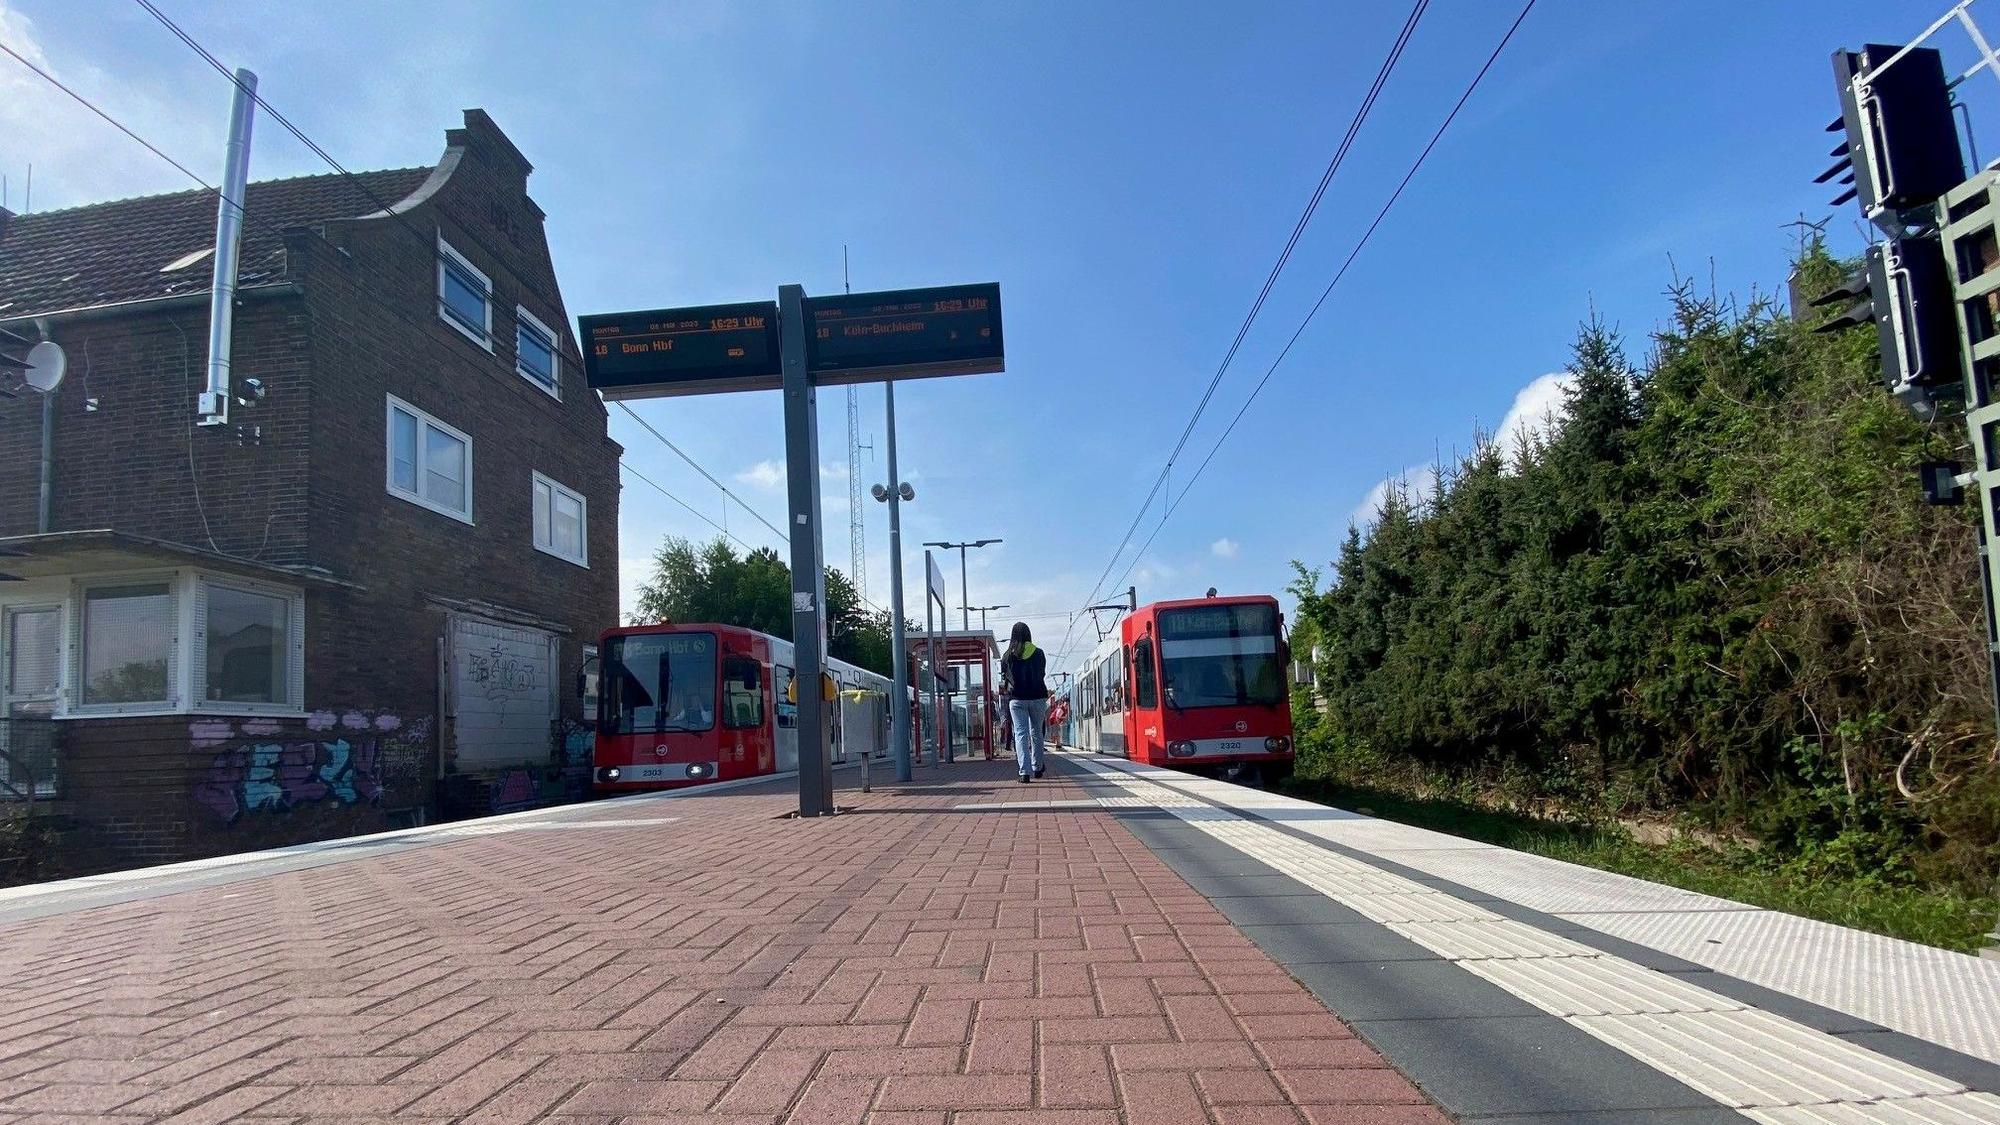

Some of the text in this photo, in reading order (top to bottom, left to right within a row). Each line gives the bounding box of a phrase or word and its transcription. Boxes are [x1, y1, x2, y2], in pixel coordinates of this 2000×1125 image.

[935, 299, 961, 311] 16:29
[968, 297, 988, 308] Uhr
[592, 326, 620, 335] MONTAG
[711, 318, 738, 330] 16:29
[744, 316, 764, 327] Uhr
[816, 327, 830, 338] 18
[596, 340, 673, 355] 18 Bonn Hbf
[1220, 742, 1241, 751] 2320
[642, 768, 663, 778] 2303
